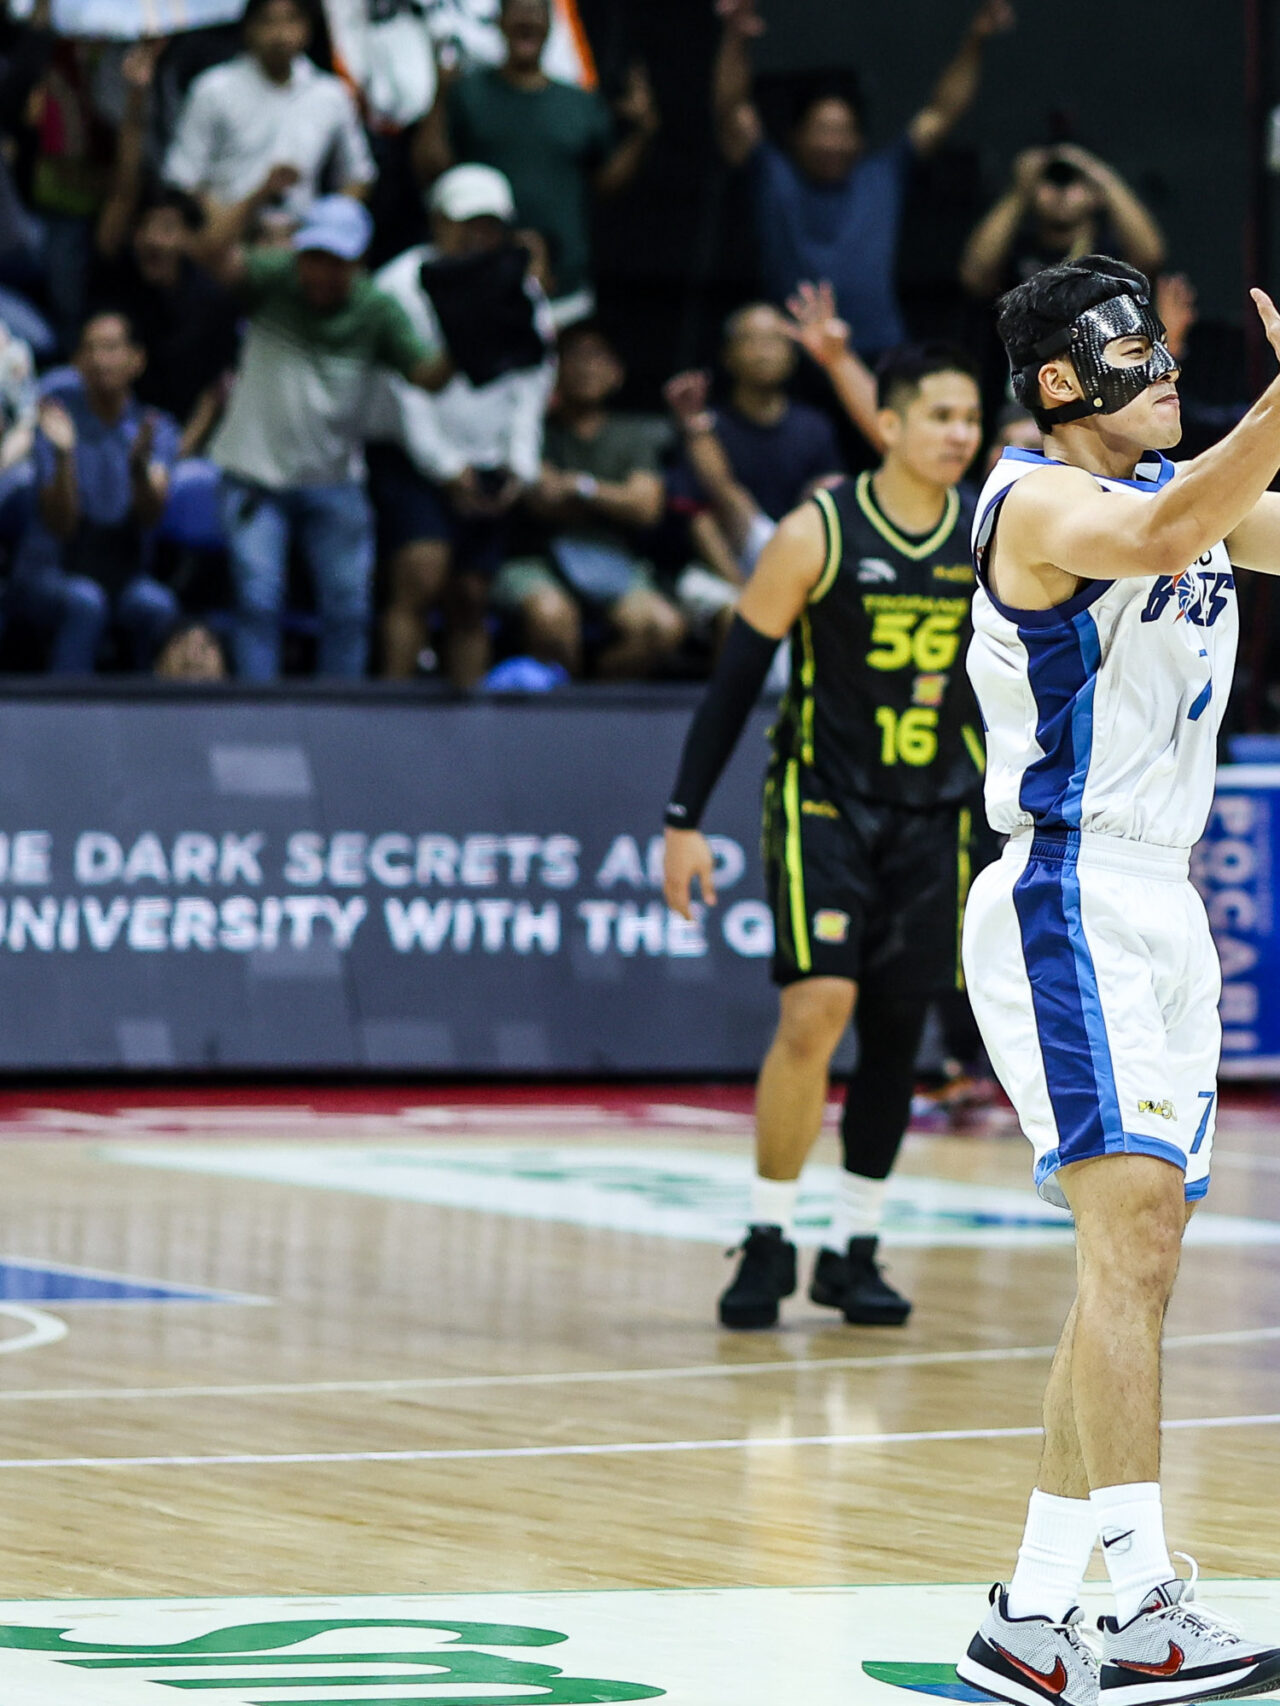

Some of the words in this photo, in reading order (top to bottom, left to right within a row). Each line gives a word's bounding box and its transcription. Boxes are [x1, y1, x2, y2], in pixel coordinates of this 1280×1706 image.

[875, 706, 938, 766] 16
[0, 830, 51, 886] E
[74, 831, 264, 886] DARK
[284, 832, 580, 888] SECRETS
[0, 895, 366, 951] NIVERSITY
[385, 897, 561, 954] WITH
[578, 899, 709, 957] THE
[1189, 1091, 1216, 1154] 7
